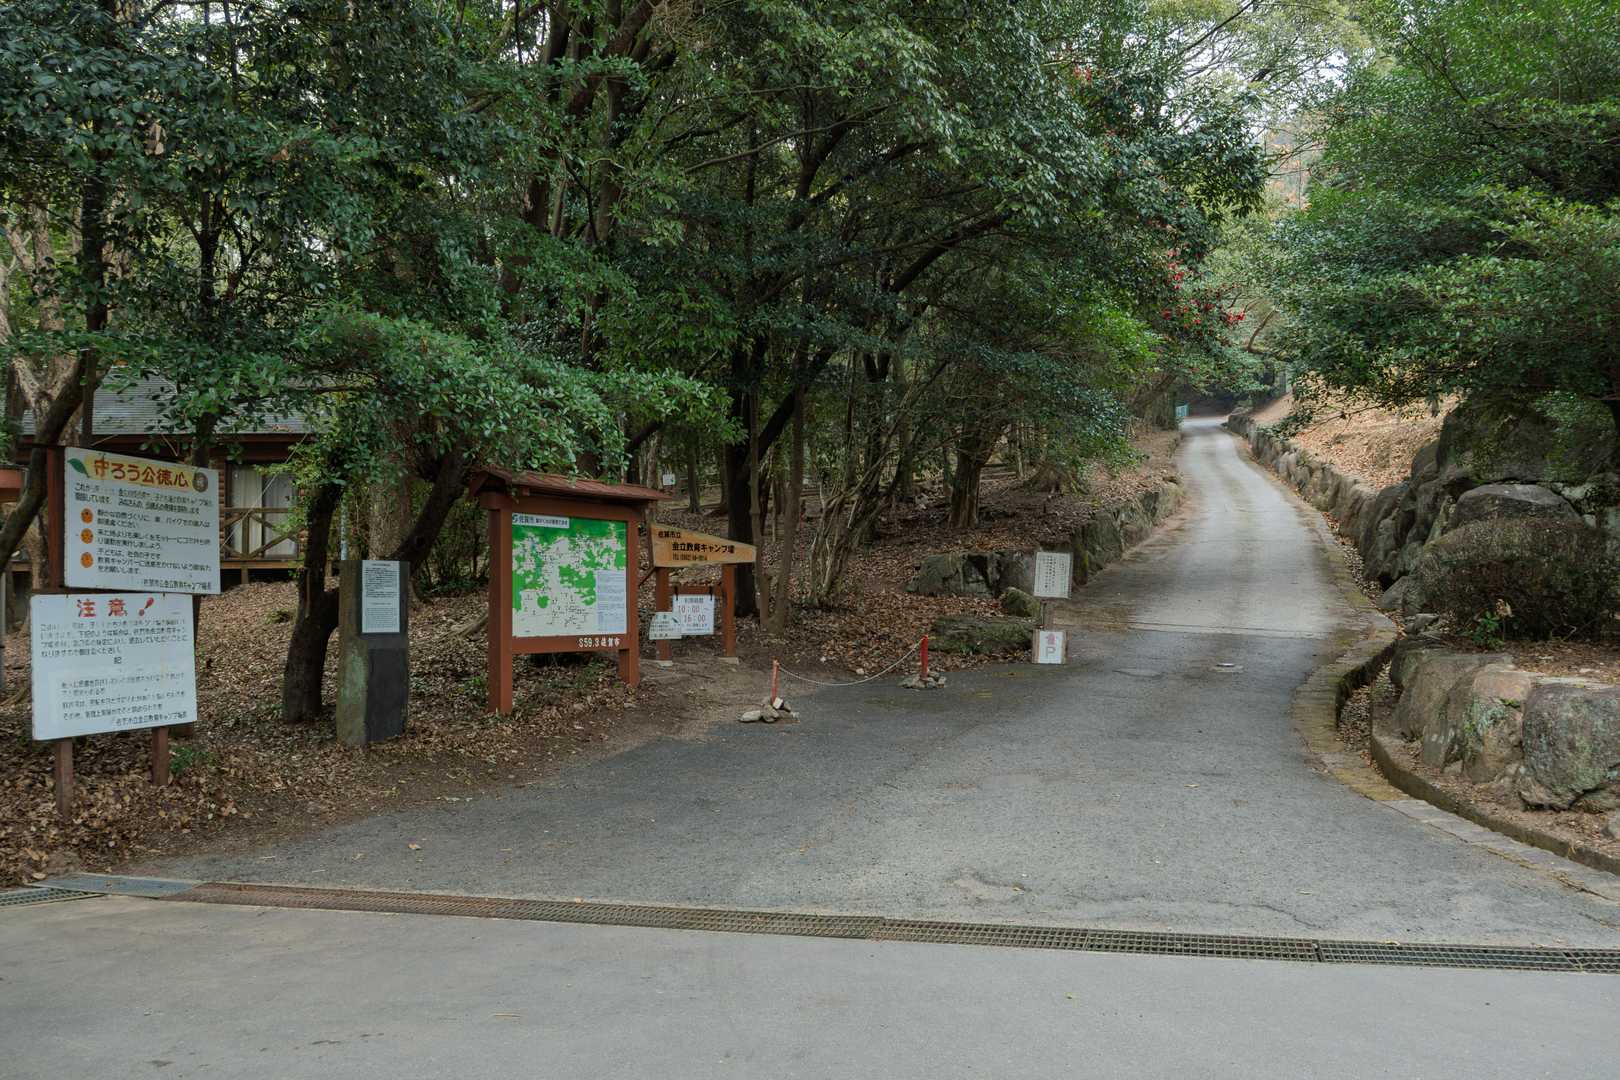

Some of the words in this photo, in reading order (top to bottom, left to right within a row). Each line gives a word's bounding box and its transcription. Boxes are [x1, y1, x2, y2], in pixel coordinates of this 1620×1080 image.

[94, 454, 189, 488] 守ろう公徳心
[1045, 645, 1056, 660] P
